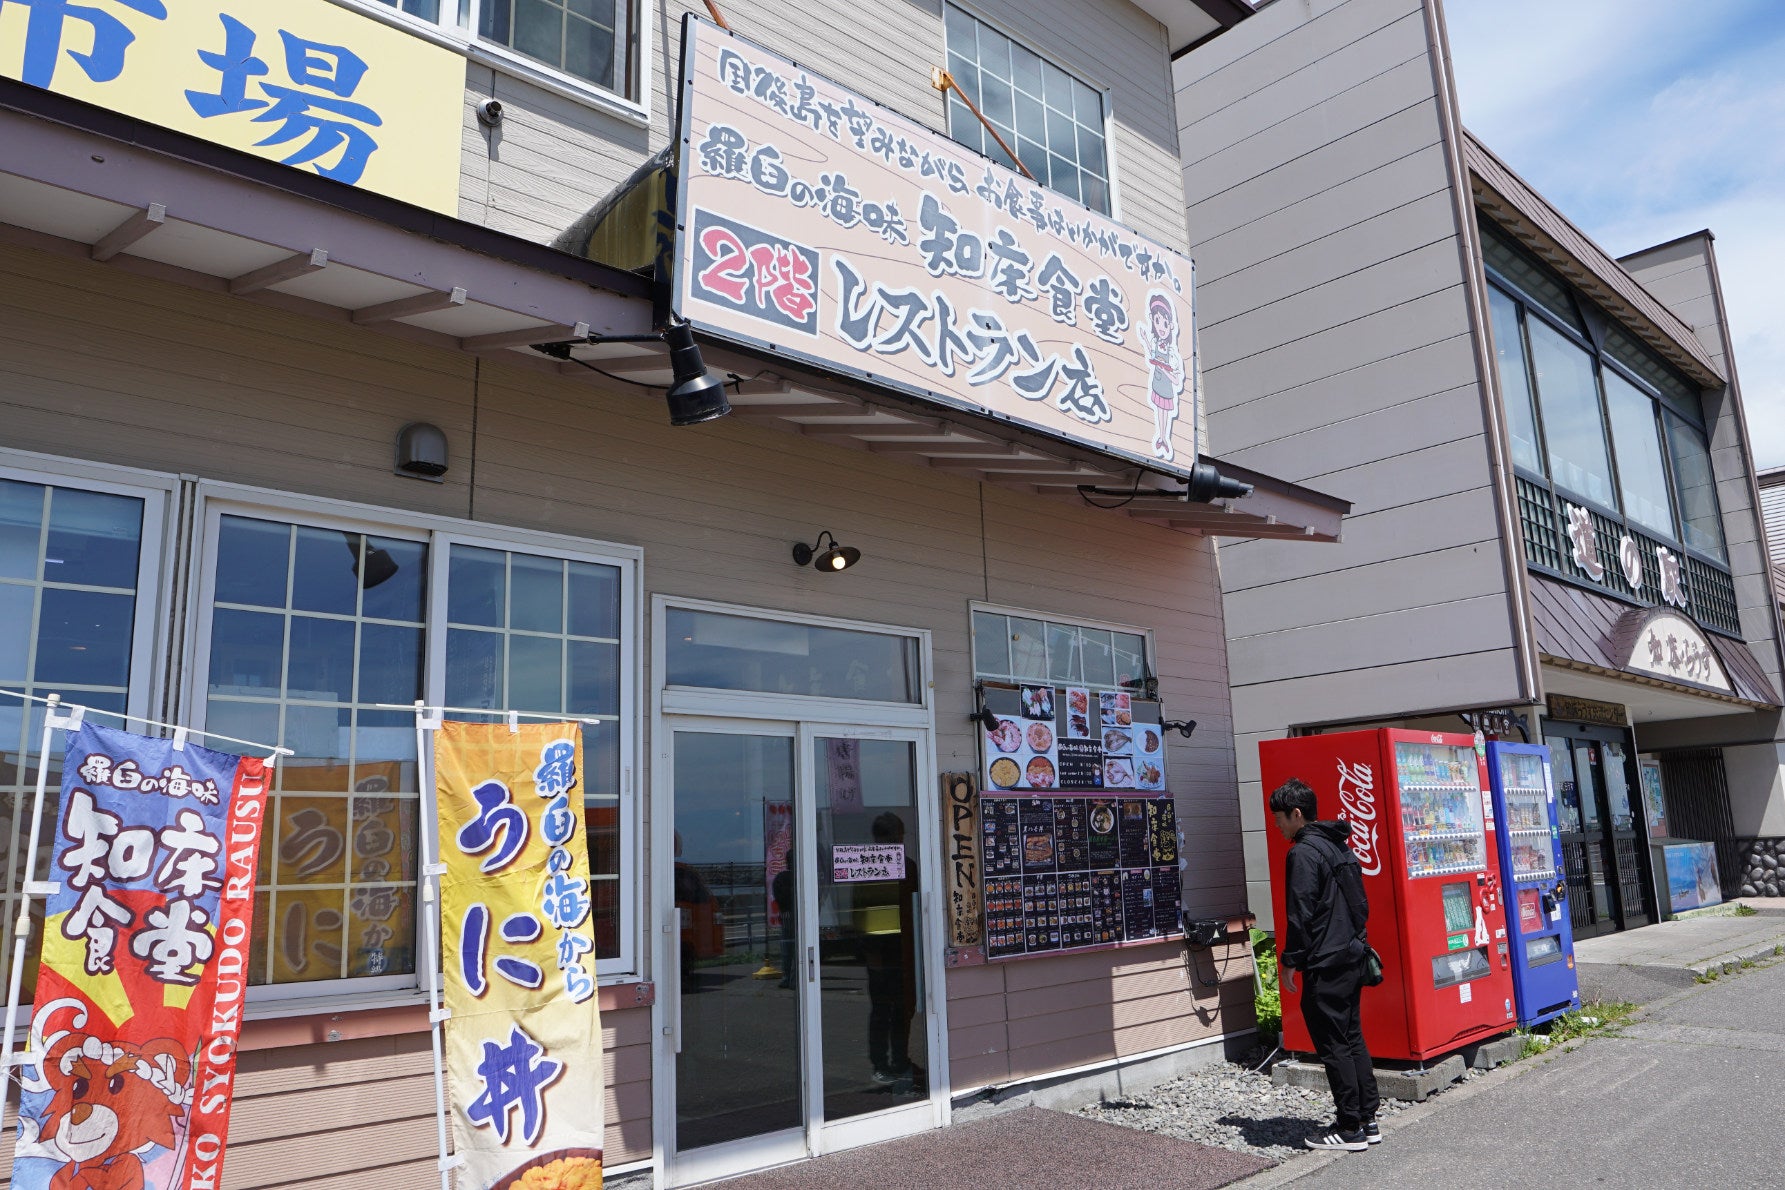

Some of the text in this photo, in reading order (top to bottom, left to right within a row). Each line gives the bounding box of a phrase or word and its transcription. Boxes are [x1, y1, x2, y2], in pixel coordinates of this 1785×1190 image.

[699, 125, 910, 245] 羅臼の海味
[917, 192, 1130, 345] 知床食堂
[718, 46, 1182, 294] 国後島を望みながら お食事はいかがですか。
[699, 225, 817, 323] 2階
[830, 253, 1113, 423] レストラン店
[79, 752, 221, 807] 羅臼の海味
[535, 738, 596, 1005] 羅臼の海から
[949, 771, 975, 889] OPEN
[198, 917, 247, 1115] SYOKUDO
[225, 771, 270, 902] RAUSU
[458, 778, 563, 1147] うに丼
